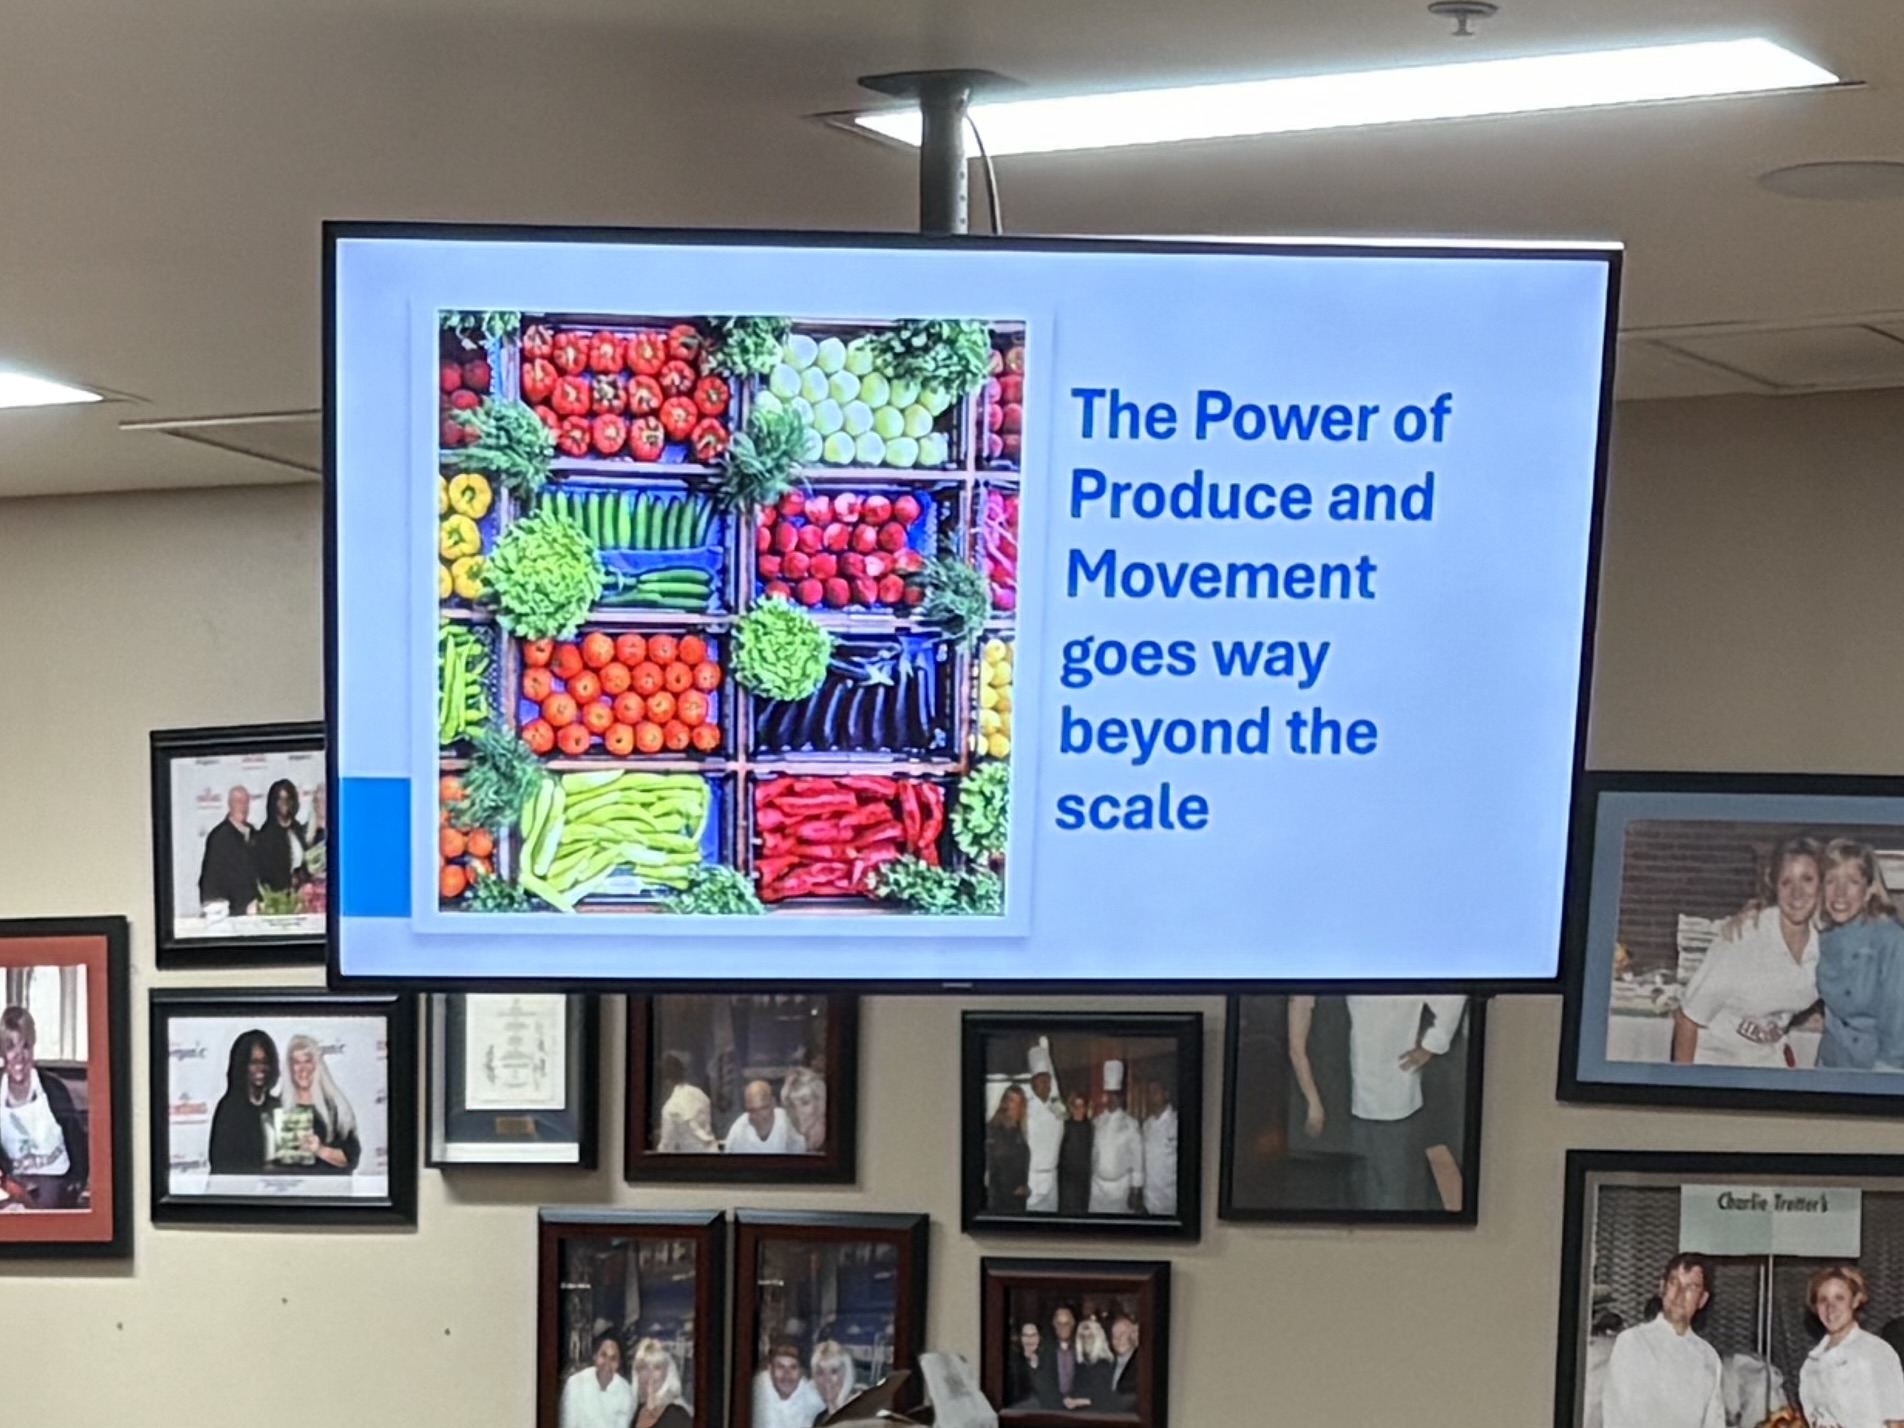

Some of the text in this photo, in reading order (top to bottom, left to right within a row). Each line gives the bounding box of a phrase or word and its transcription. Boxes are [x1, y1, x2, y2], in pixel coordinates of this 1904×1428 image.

[1072, 388, 1453, 443] The Power of
[1071, 468, 1435, 521] Produce and
[1067, 548, 1377, 599] Movement
[1060, 636, 1330, 689] goes way
[1060, 705, 1378, 766] beyond the
[1055, 782, 1209, 831] scale
[1718, 1190, 1768, 1212] Charlie
